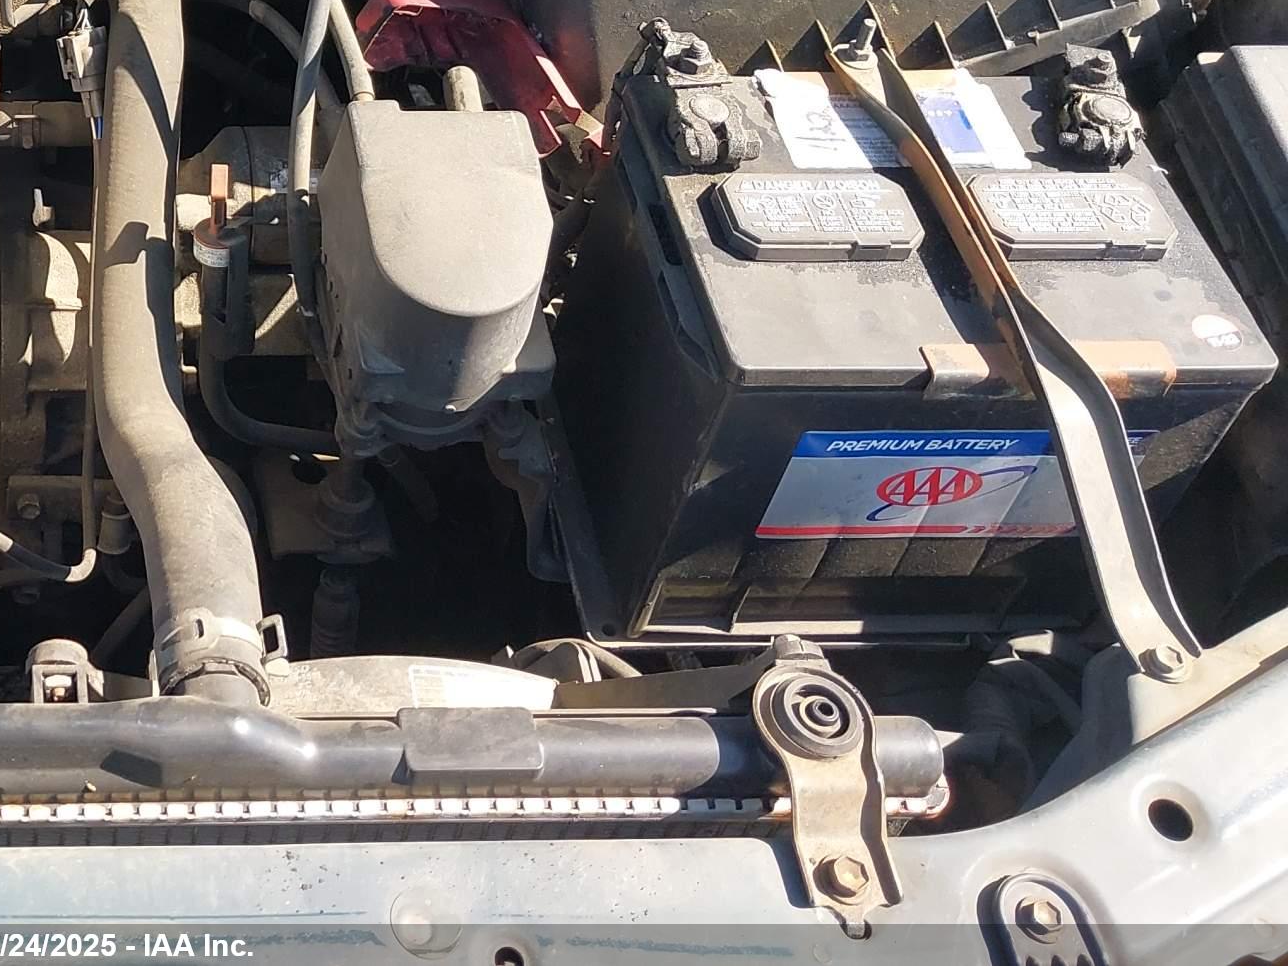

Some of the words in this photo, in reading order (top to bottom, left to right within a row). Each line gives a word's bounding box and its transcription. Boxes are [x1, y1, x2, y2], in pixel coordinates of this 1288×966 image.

[826, 439, 925, 452] PREMIUM
[925, 438, 1018, 452] BATTERY
[881, 468, 979, 505] AAA
